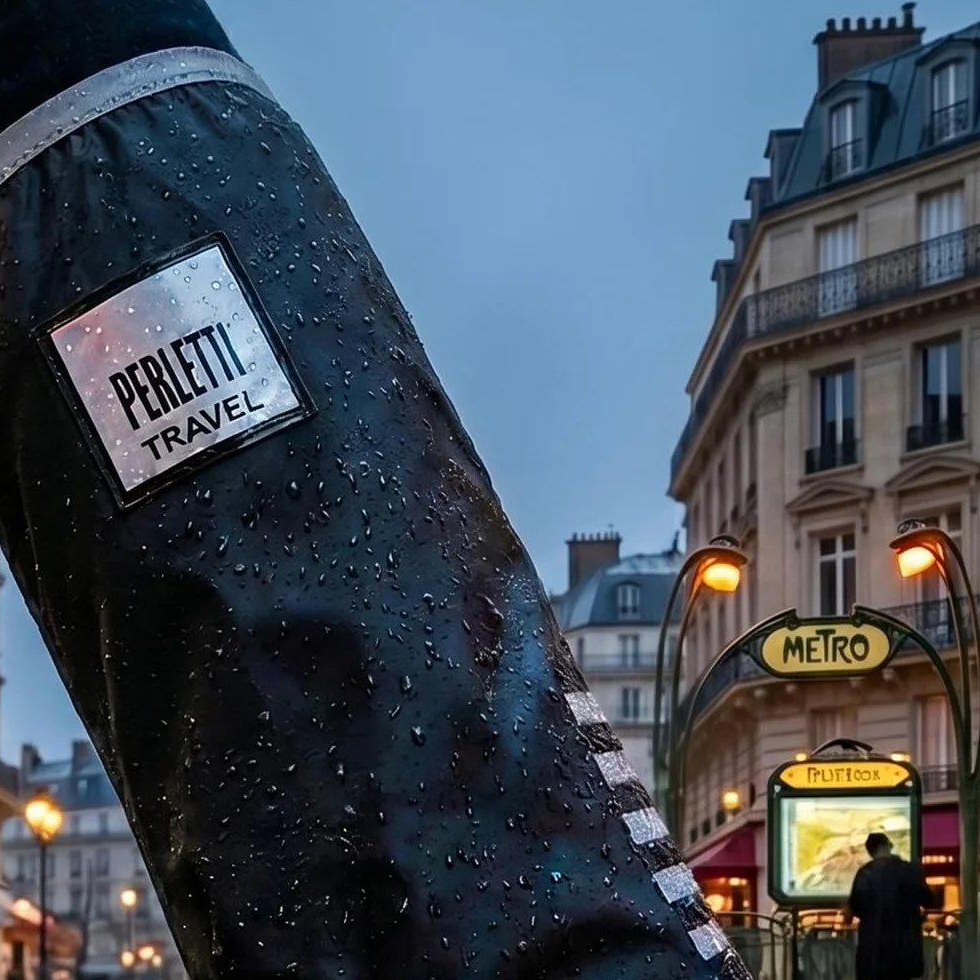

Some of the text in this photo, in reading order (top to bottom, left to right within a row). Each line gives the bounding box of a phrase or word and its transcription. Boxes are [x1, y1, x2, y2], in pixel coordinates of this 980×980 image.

[108, 321, 247, 431] PERLETTI
[140, 390, 264, 461] TRAVEL
[782, 628, 870, 664] METRO
